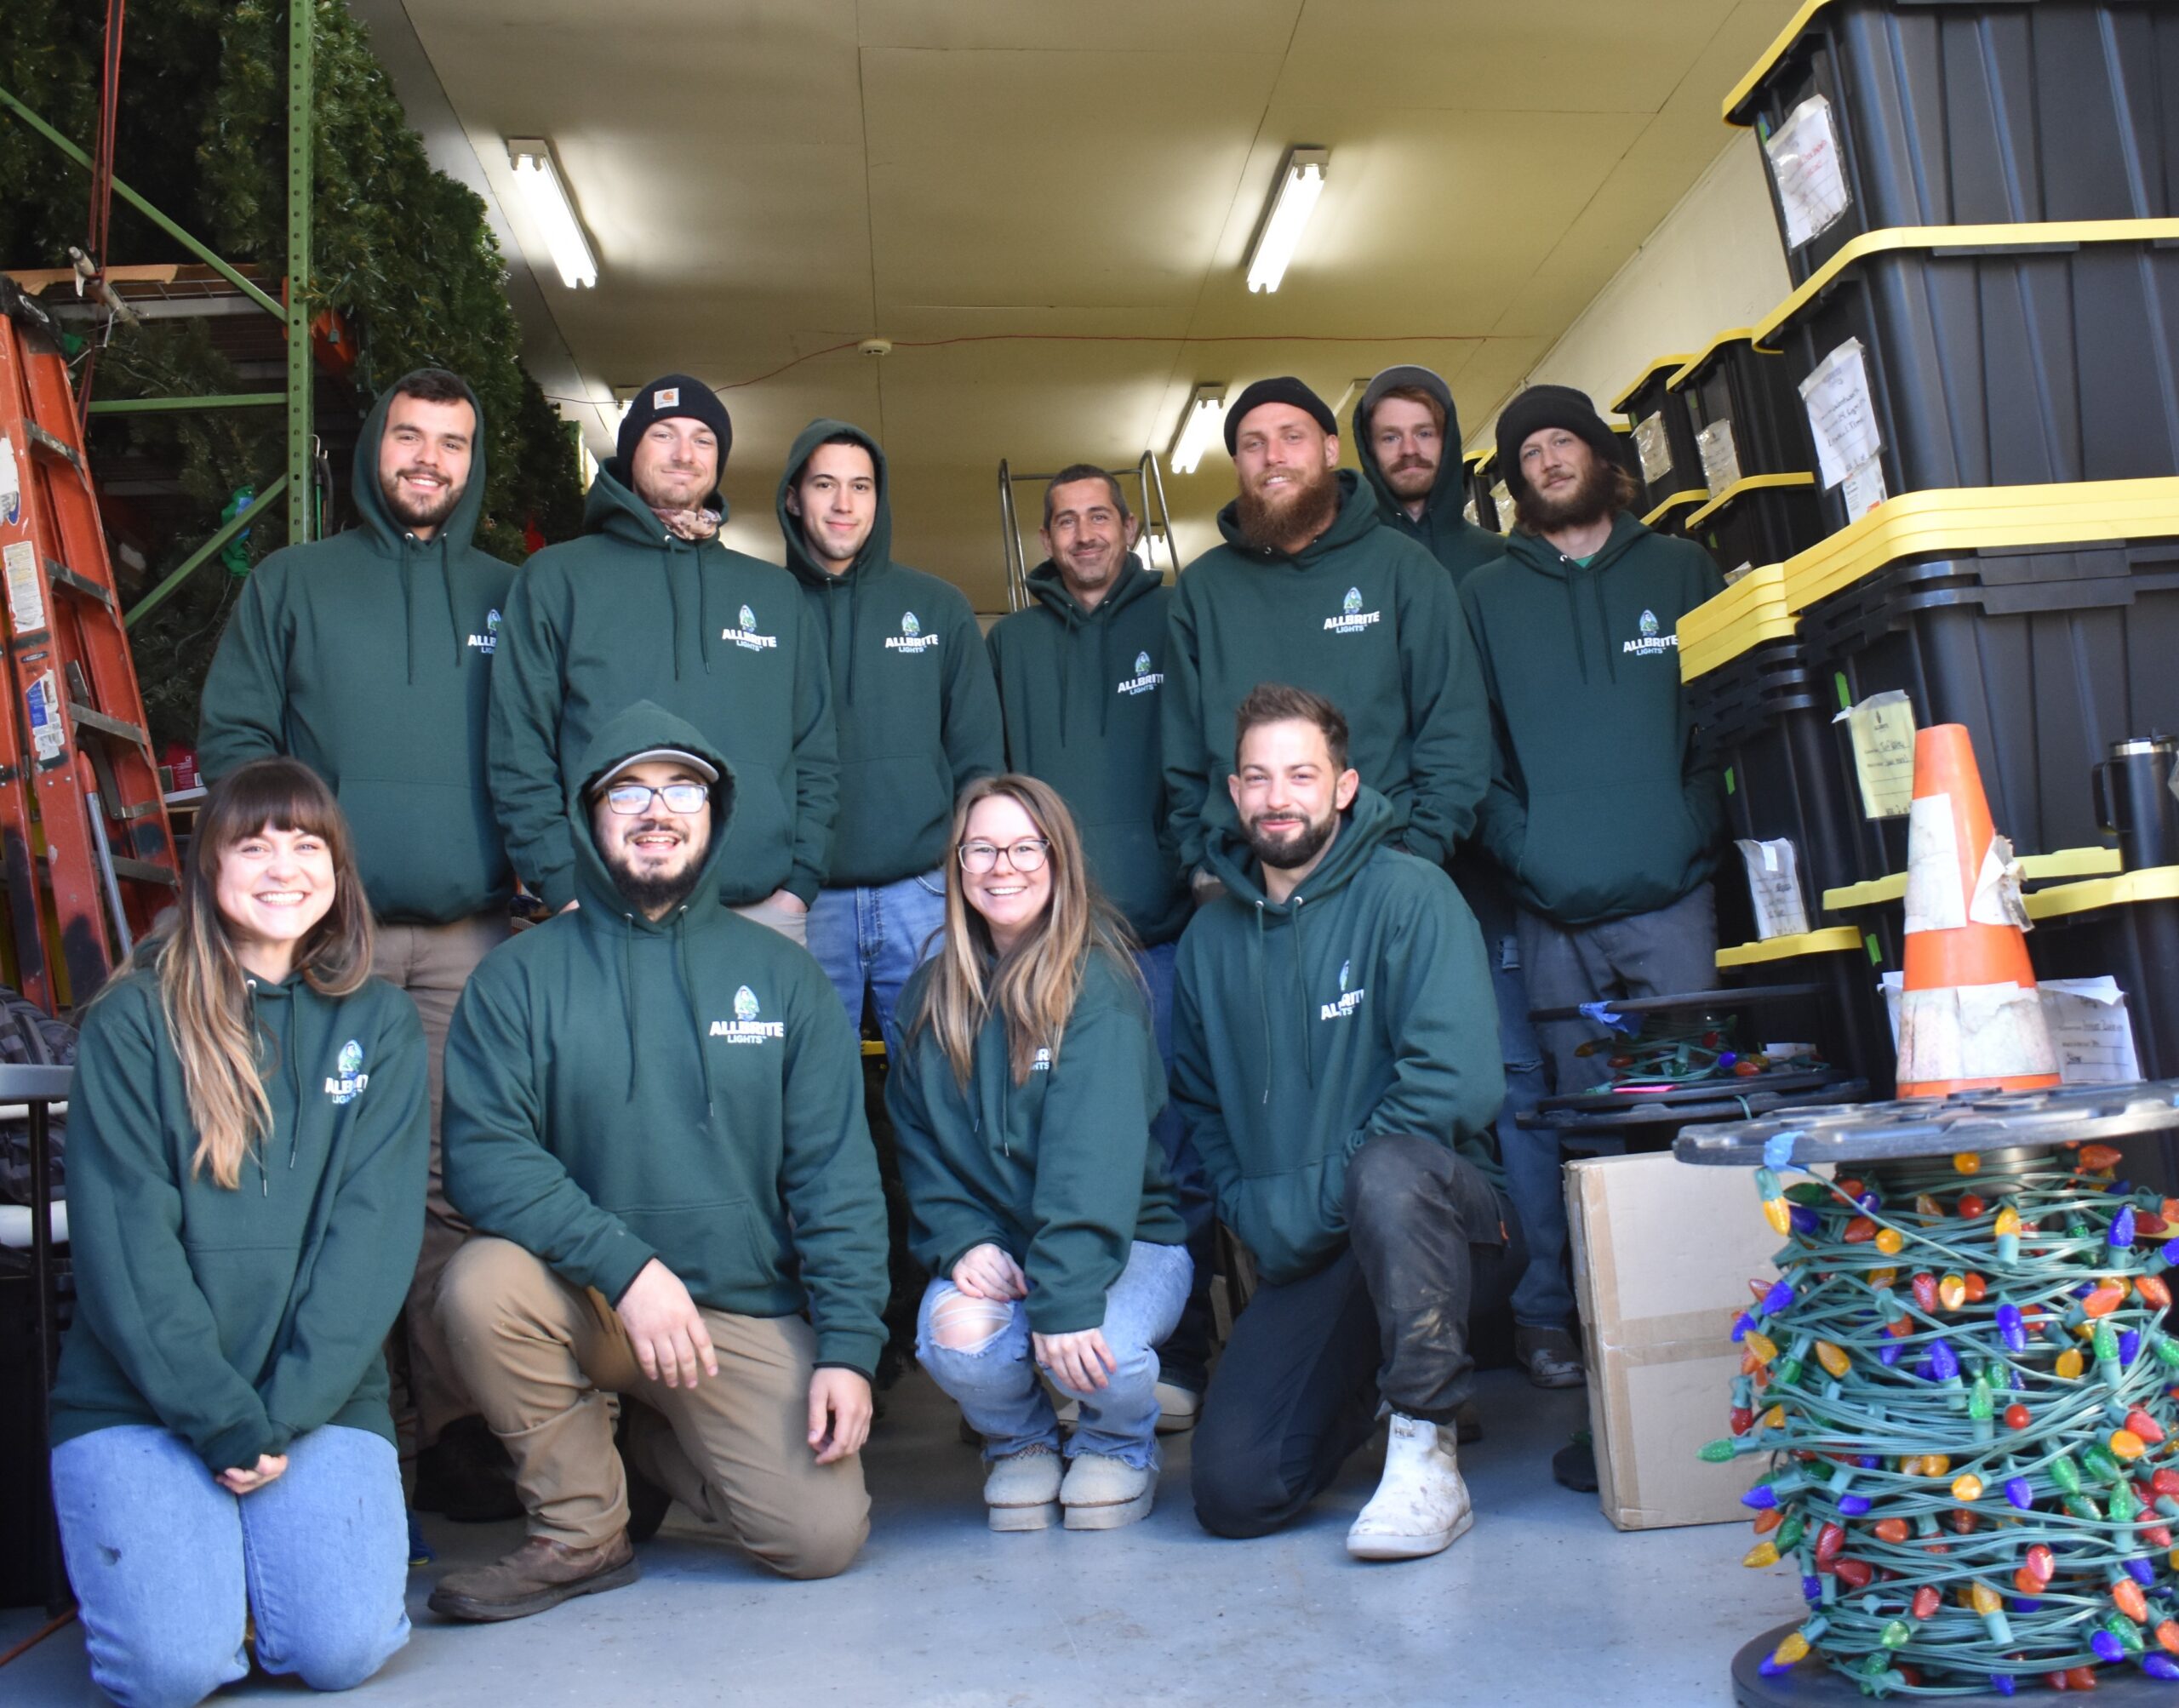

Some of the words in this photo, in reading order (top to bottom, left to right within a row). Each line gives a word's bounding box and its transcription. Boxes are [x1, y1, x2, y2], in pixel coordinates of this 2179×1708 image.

[1324, 610, 1380, 630] ALLBRITE
[722, 629, 777, 647] ALLBRITE
[885, 634, 939, 648] ALLBRITE
[1623, 634, 1679, 653] ALLBRITE
[1636, 648, 1663, 656] LIGHTS
[1130, 684, 1154, 694] LIGHTS
[709, 1021, 784, 1037] ALLBRITE
[727, 1035, 764, 1044] LIGHTS
